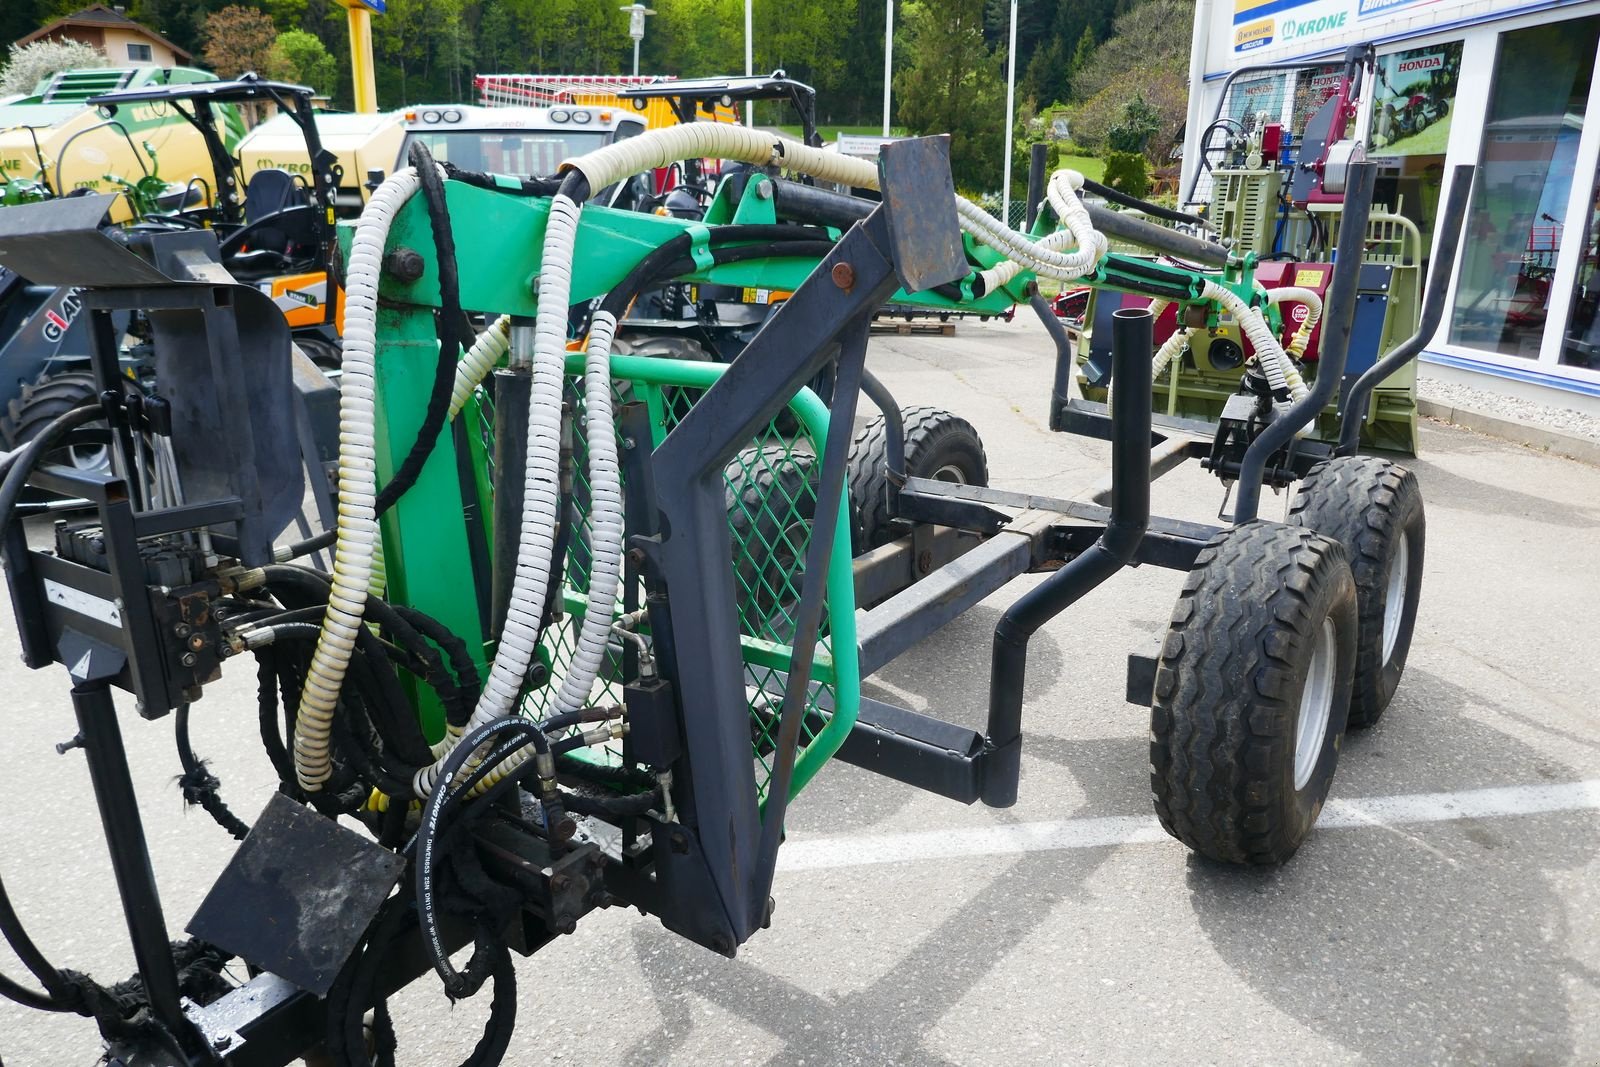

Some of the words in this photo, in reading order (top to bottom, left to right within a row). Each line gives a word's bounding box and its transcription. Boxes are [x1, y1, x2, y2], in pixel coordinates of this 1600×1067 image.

[1253, 25, 1271, 35] HOLLAND
[1296, 11, 1348, 37] KRONE
[1398, 57, 1441, 72] HONDA
[1245, 85, 1273, 96] HONDA
[42, 286, 84, 343] GIAN
[429, 784, 447, 830] CHANGYE
[424, 892, 432, 911] DN10
